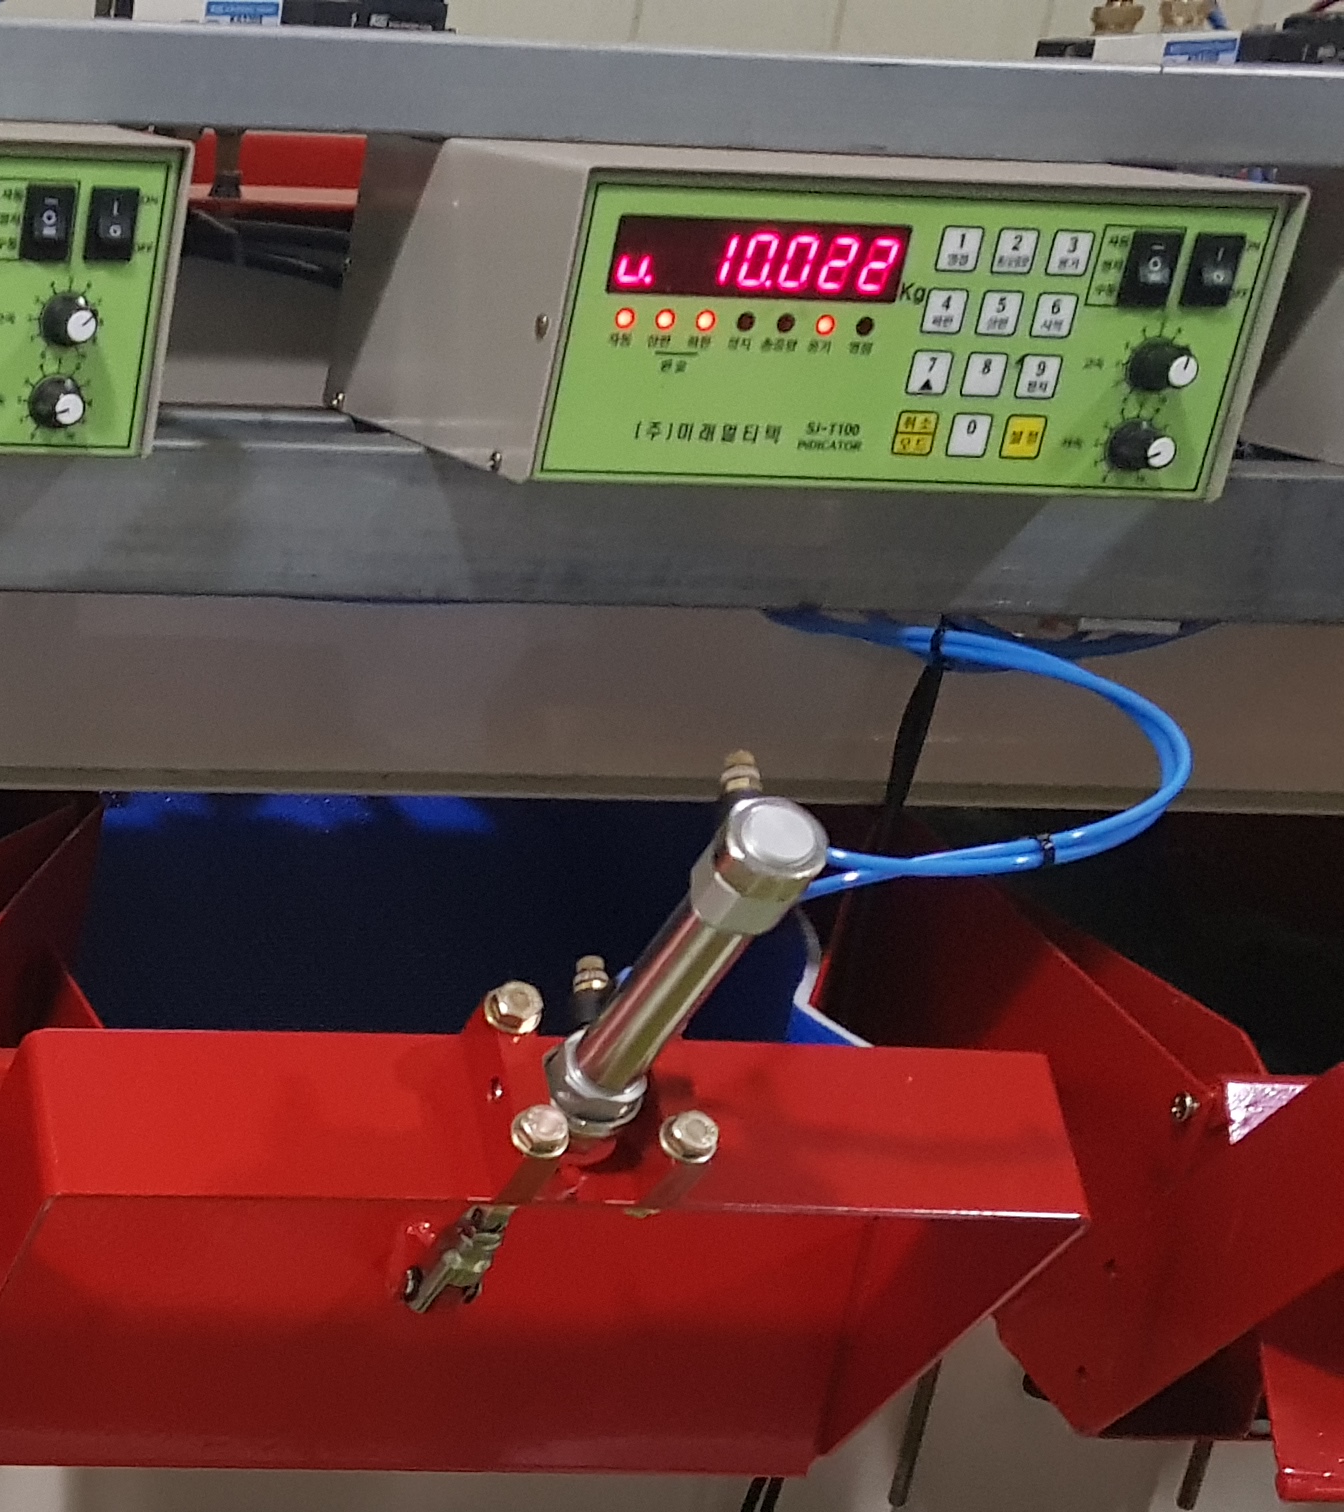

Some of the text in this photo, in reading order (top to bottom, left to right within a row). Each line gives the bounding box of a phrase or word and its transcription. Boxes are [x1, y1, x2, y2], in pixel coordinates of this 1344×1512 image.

[716, 231, 902, 295] 10.022
[901, 283, 926, 305] Kg
[805, 421, 860, 436] SJ-T100
[797, 440, 862, 451] INDICATOR
